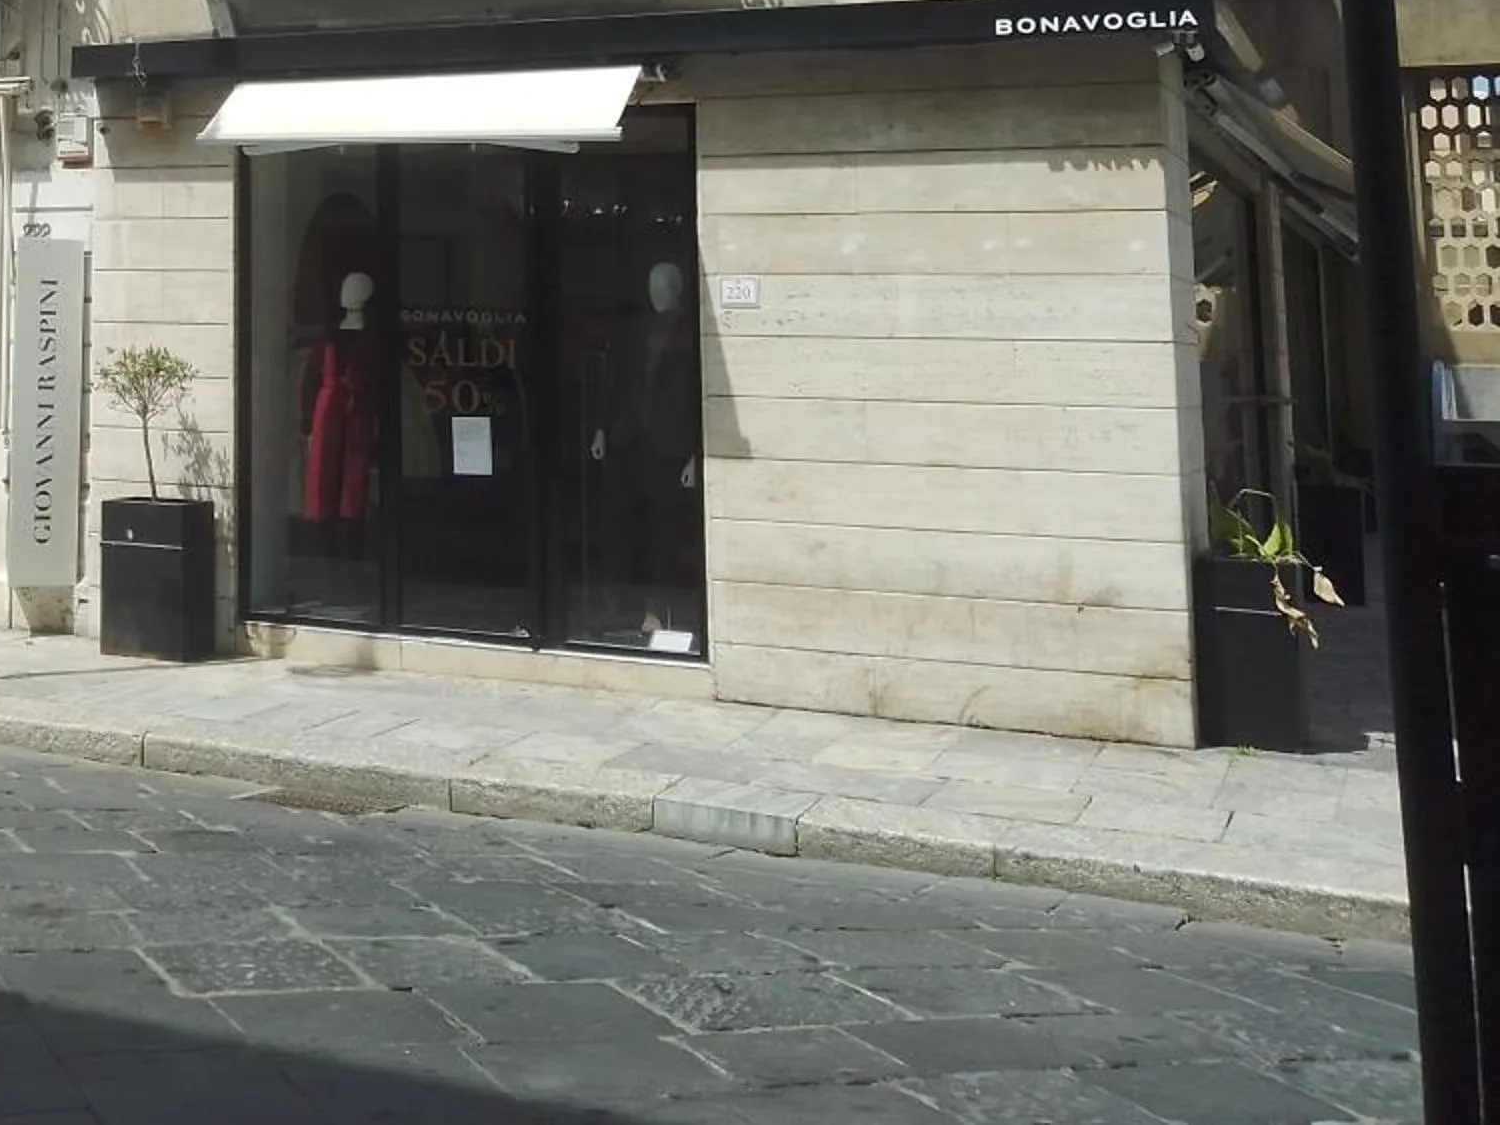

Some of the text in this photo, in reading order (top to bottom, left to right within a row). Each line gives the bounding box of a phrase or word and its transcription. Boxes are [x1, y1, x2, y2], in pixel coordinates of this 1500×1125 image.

[995, 9, 1198, 36] BONAVOGLIA
[726, 286, 751, 300] 220
[407, 329, 517, 369] SALDI
[34, 279, 59, 544] GIOVANNI RASPINI
[422, 380, 506, 416] 50%
